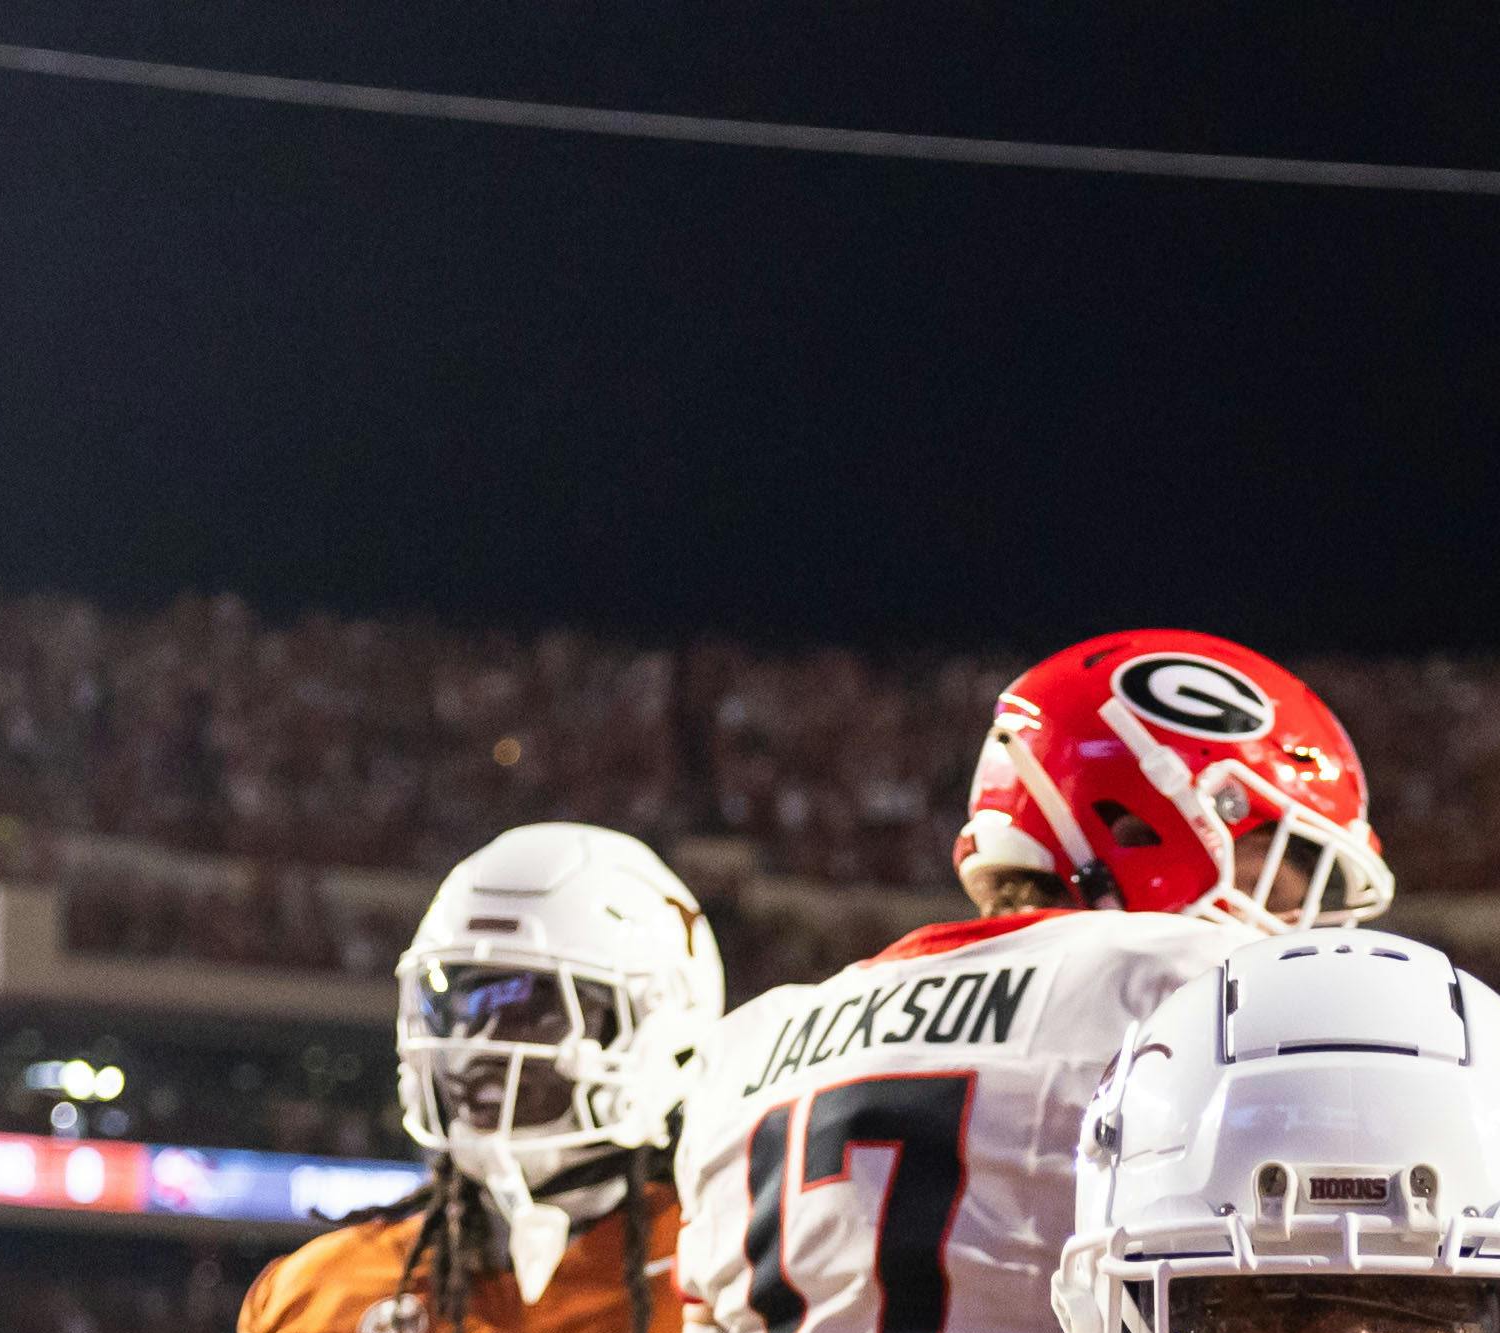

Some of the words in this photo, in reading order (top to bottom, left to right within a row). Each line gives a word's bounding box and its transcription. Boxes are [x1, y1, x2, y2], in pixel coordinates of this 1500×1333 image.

[1118, 658, 1267, 735] G
[742, 966, 1037, 1098] JACKSON
[1308, 1176, 1389, 1200] HORNS
